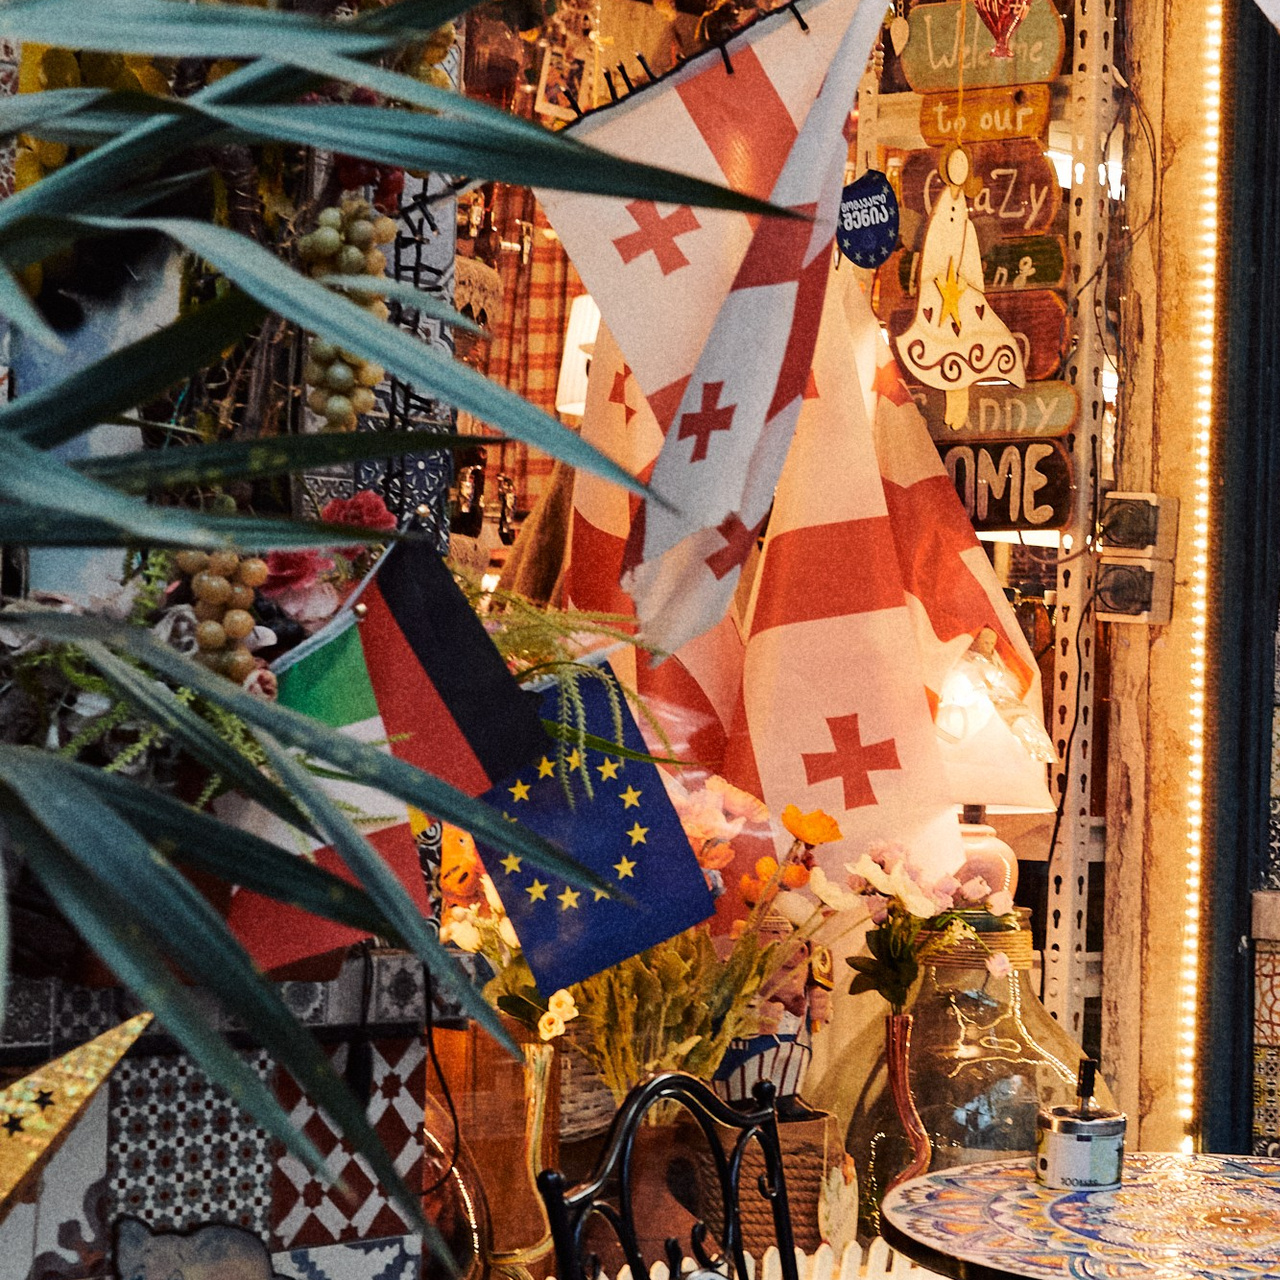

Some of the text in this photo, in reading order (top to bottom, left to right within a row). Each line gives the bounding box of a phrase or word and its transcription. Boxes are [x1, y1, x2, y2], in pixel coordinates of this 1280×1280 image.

[932, 101, 1033, 133] to our
[842, 205, 889, 232] შენია
[914, 444, 1054, 525] OME
